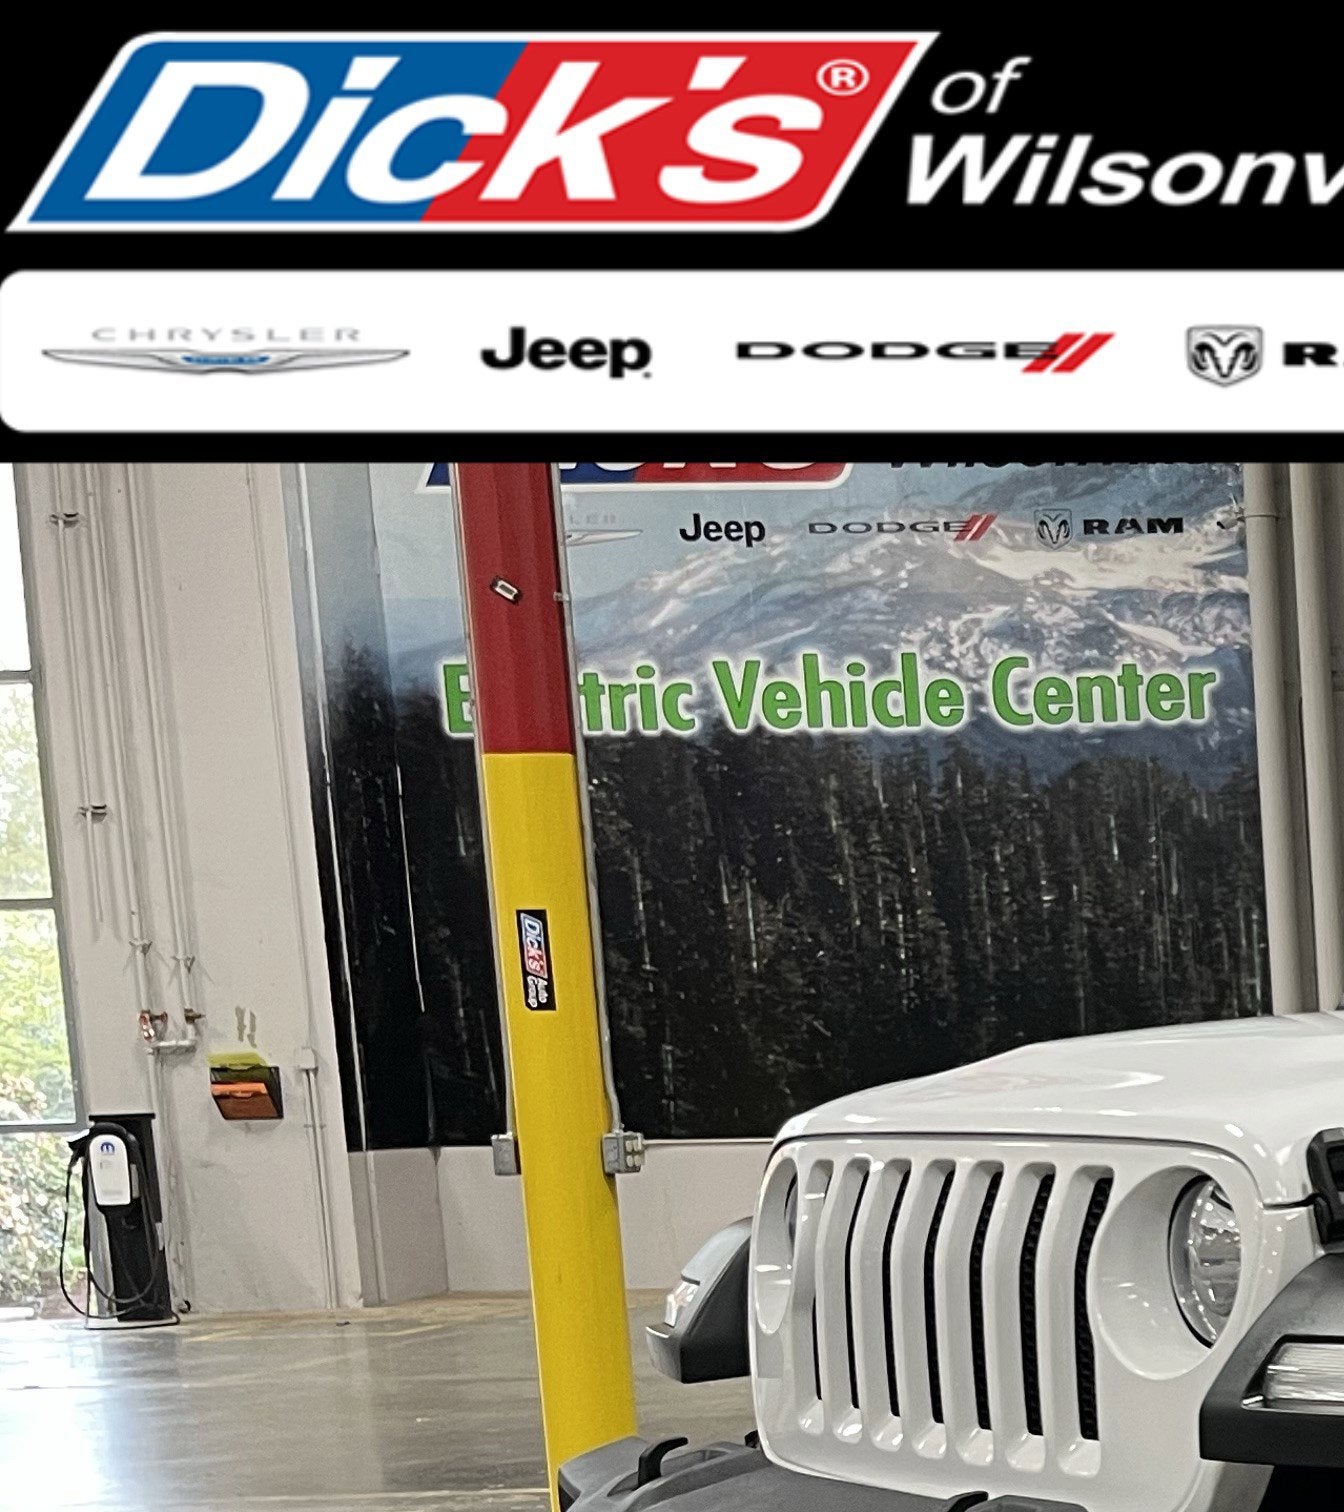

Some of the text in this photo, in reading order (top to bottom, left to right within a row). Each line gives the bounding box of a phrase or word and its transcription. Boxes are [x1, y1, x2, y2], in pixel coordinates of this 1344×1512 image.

[680, 513, 765, 547] Jeep
[808, 520, 968, 535] DODGE
[1083, 517, 1184, 536] RAM
[442, 653, 1217, 734] Etric Vehicle Center
[525, 918, 544, 973] Dick's
